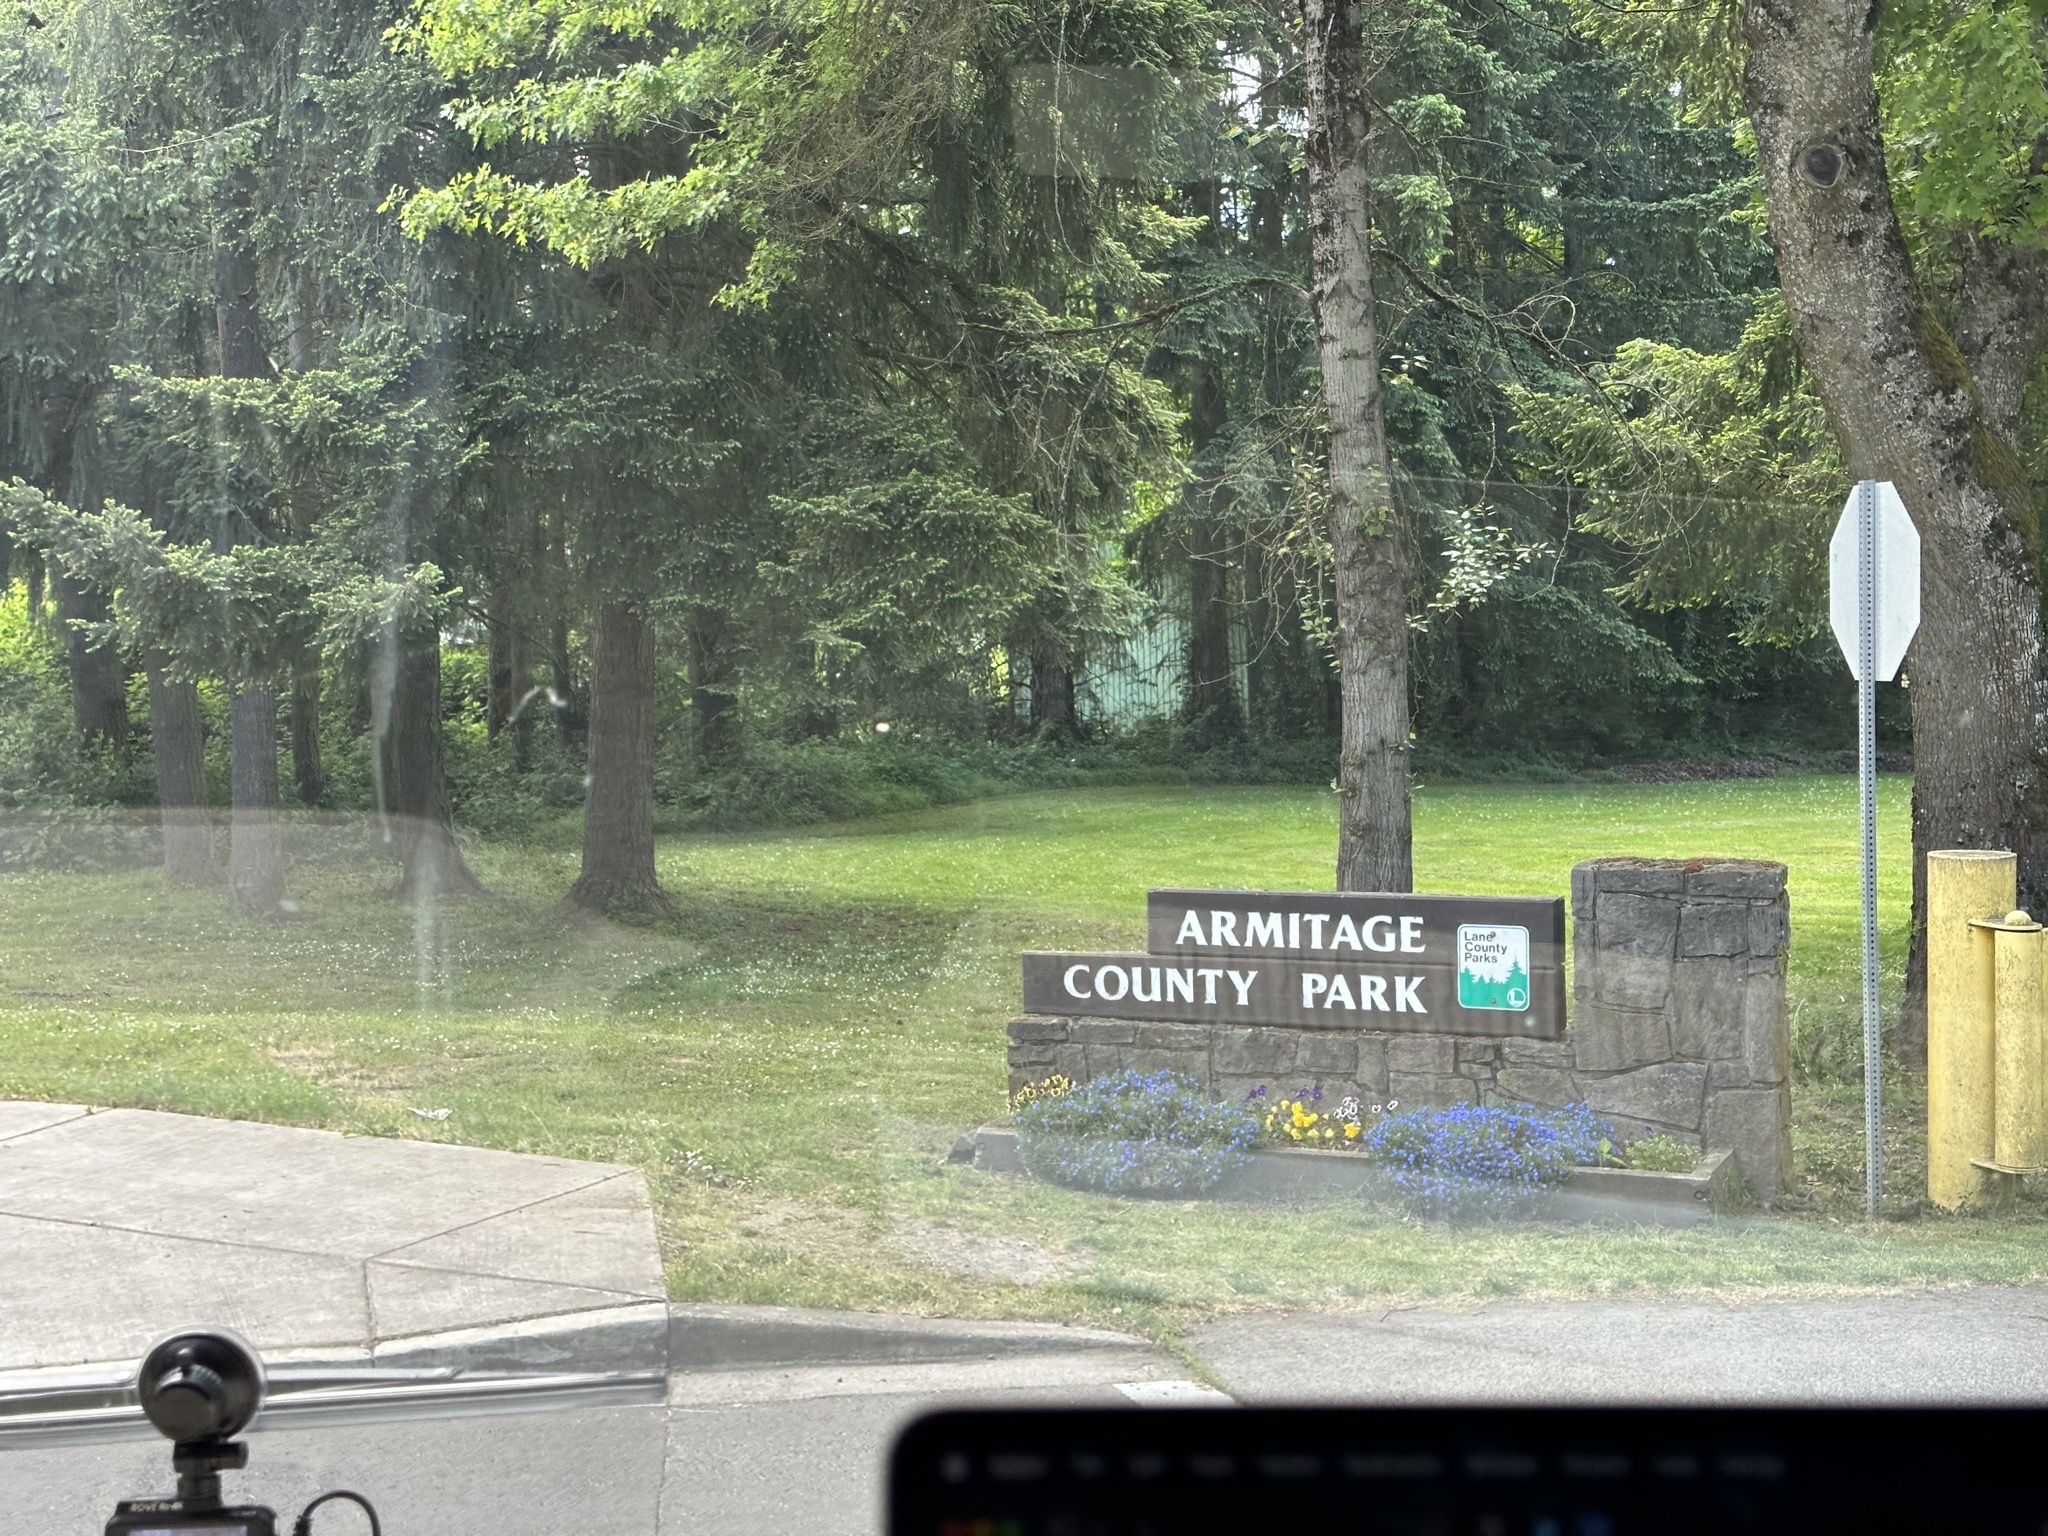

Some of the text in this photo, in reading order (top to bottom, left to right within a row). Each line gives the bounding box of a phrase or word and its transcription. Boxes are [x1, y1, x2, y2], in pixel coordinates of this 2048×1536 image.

[1175, 909, 1426, 953] ARMITAGE
[1464, 931, 1494, 942] Lane
[1464, 942, 1507, 955] County
[1464, 952, 1498, 963] Parks
[1063, 964, 1428, 1013] COUNTY PARK
